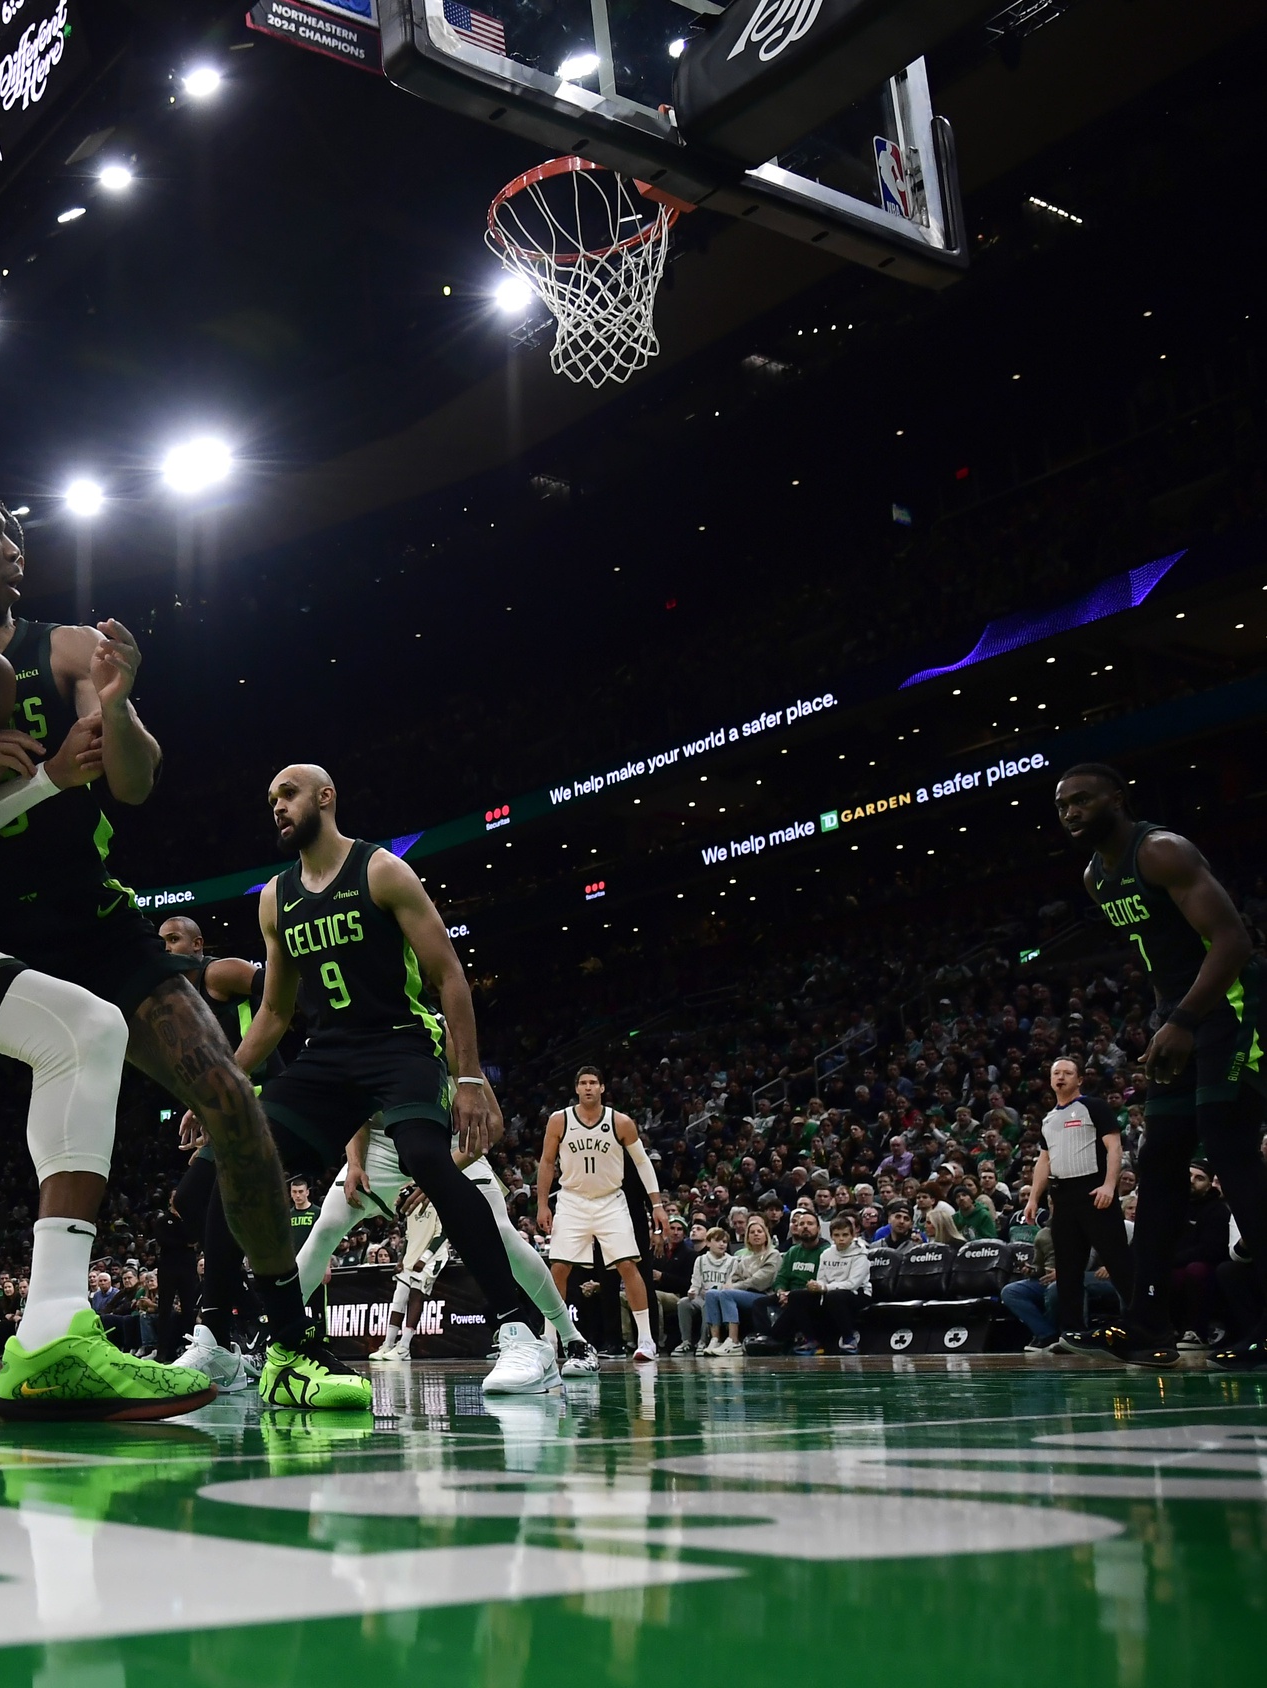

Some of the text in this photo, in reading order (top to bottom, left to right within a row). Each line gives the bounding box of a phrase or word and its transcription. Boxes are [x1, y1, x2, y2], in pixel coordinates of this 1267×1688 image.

[267, 14, 365, 59] 2024 CHAMPIONS
[272, 2, 358, 42] NORTHEASTERN
[2, 30, 65, 111] Here
[549, 693, 838, 805] We help make your world a safer place.
[701, 752, 1050, 865] We help make TD GARDEN a safer place.
[134, 890, 195, 908] fer place.
[333, 889, 360, 900] Amica
[285, 910, 364, 958] CELTICS
[1130, 933, 1152, 972] 7
[320, 961, 351, 1010] 9
[568, 1139, 610, 1154] BUCKS
[584, 1157, 595, 1174] 11
[290, 1215, 313, 1227] ELTICS
[910, 1252, 942, 1263] @celtics
[965, 1247, 999, 1259] @celtics
